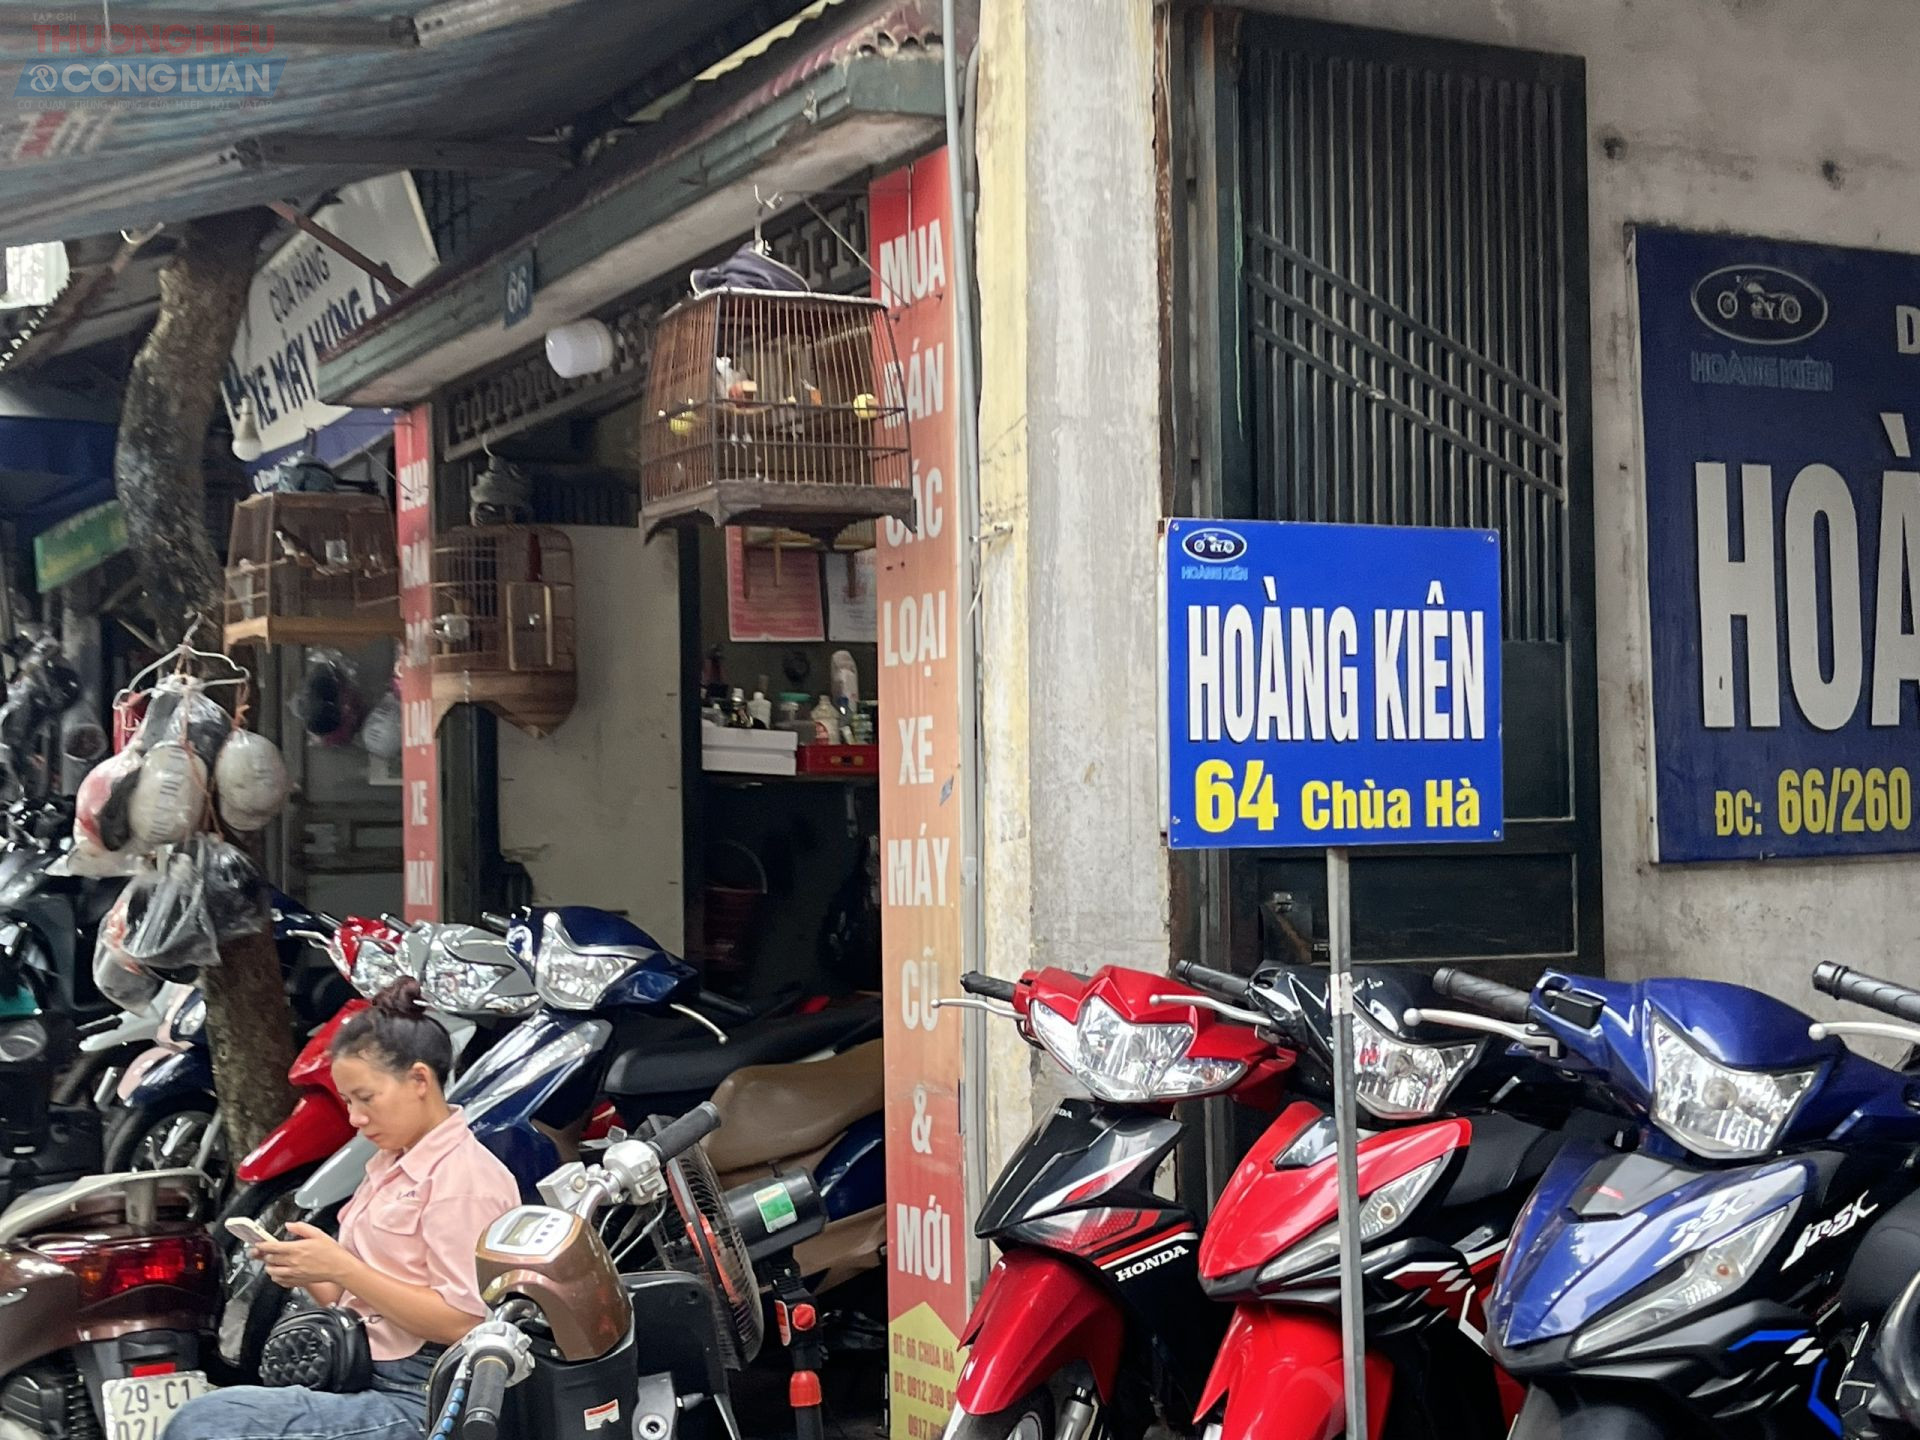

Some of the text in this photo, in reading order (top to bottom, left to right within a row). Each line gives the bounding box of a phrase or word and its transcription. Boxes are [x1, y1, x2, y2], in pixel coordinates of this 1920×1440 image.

[507, 265, 528, 313] 66
[879, 218, 946, 308] MUA
[1691, 349, 1778, 388] HOÀNG
[883, 589, 947, 678] LOẠI
[1187, 575, 1485, 743] HOÀNG KIÊN
[897, 714, 935, 786] XE
[1193, 758, 1481, 834] 64 Chùa Hà
[1714, 766, 1913, 837] ĐC: 66/260
[887, 822, 951, 907] MÁY
[911, 1084, 932, 1155] &
[896, 1194, 952, 1285] MỚI
[1115, 1244, 1190, 1283] HONDA
[121, 1378, 190, 1416] 29-C1
